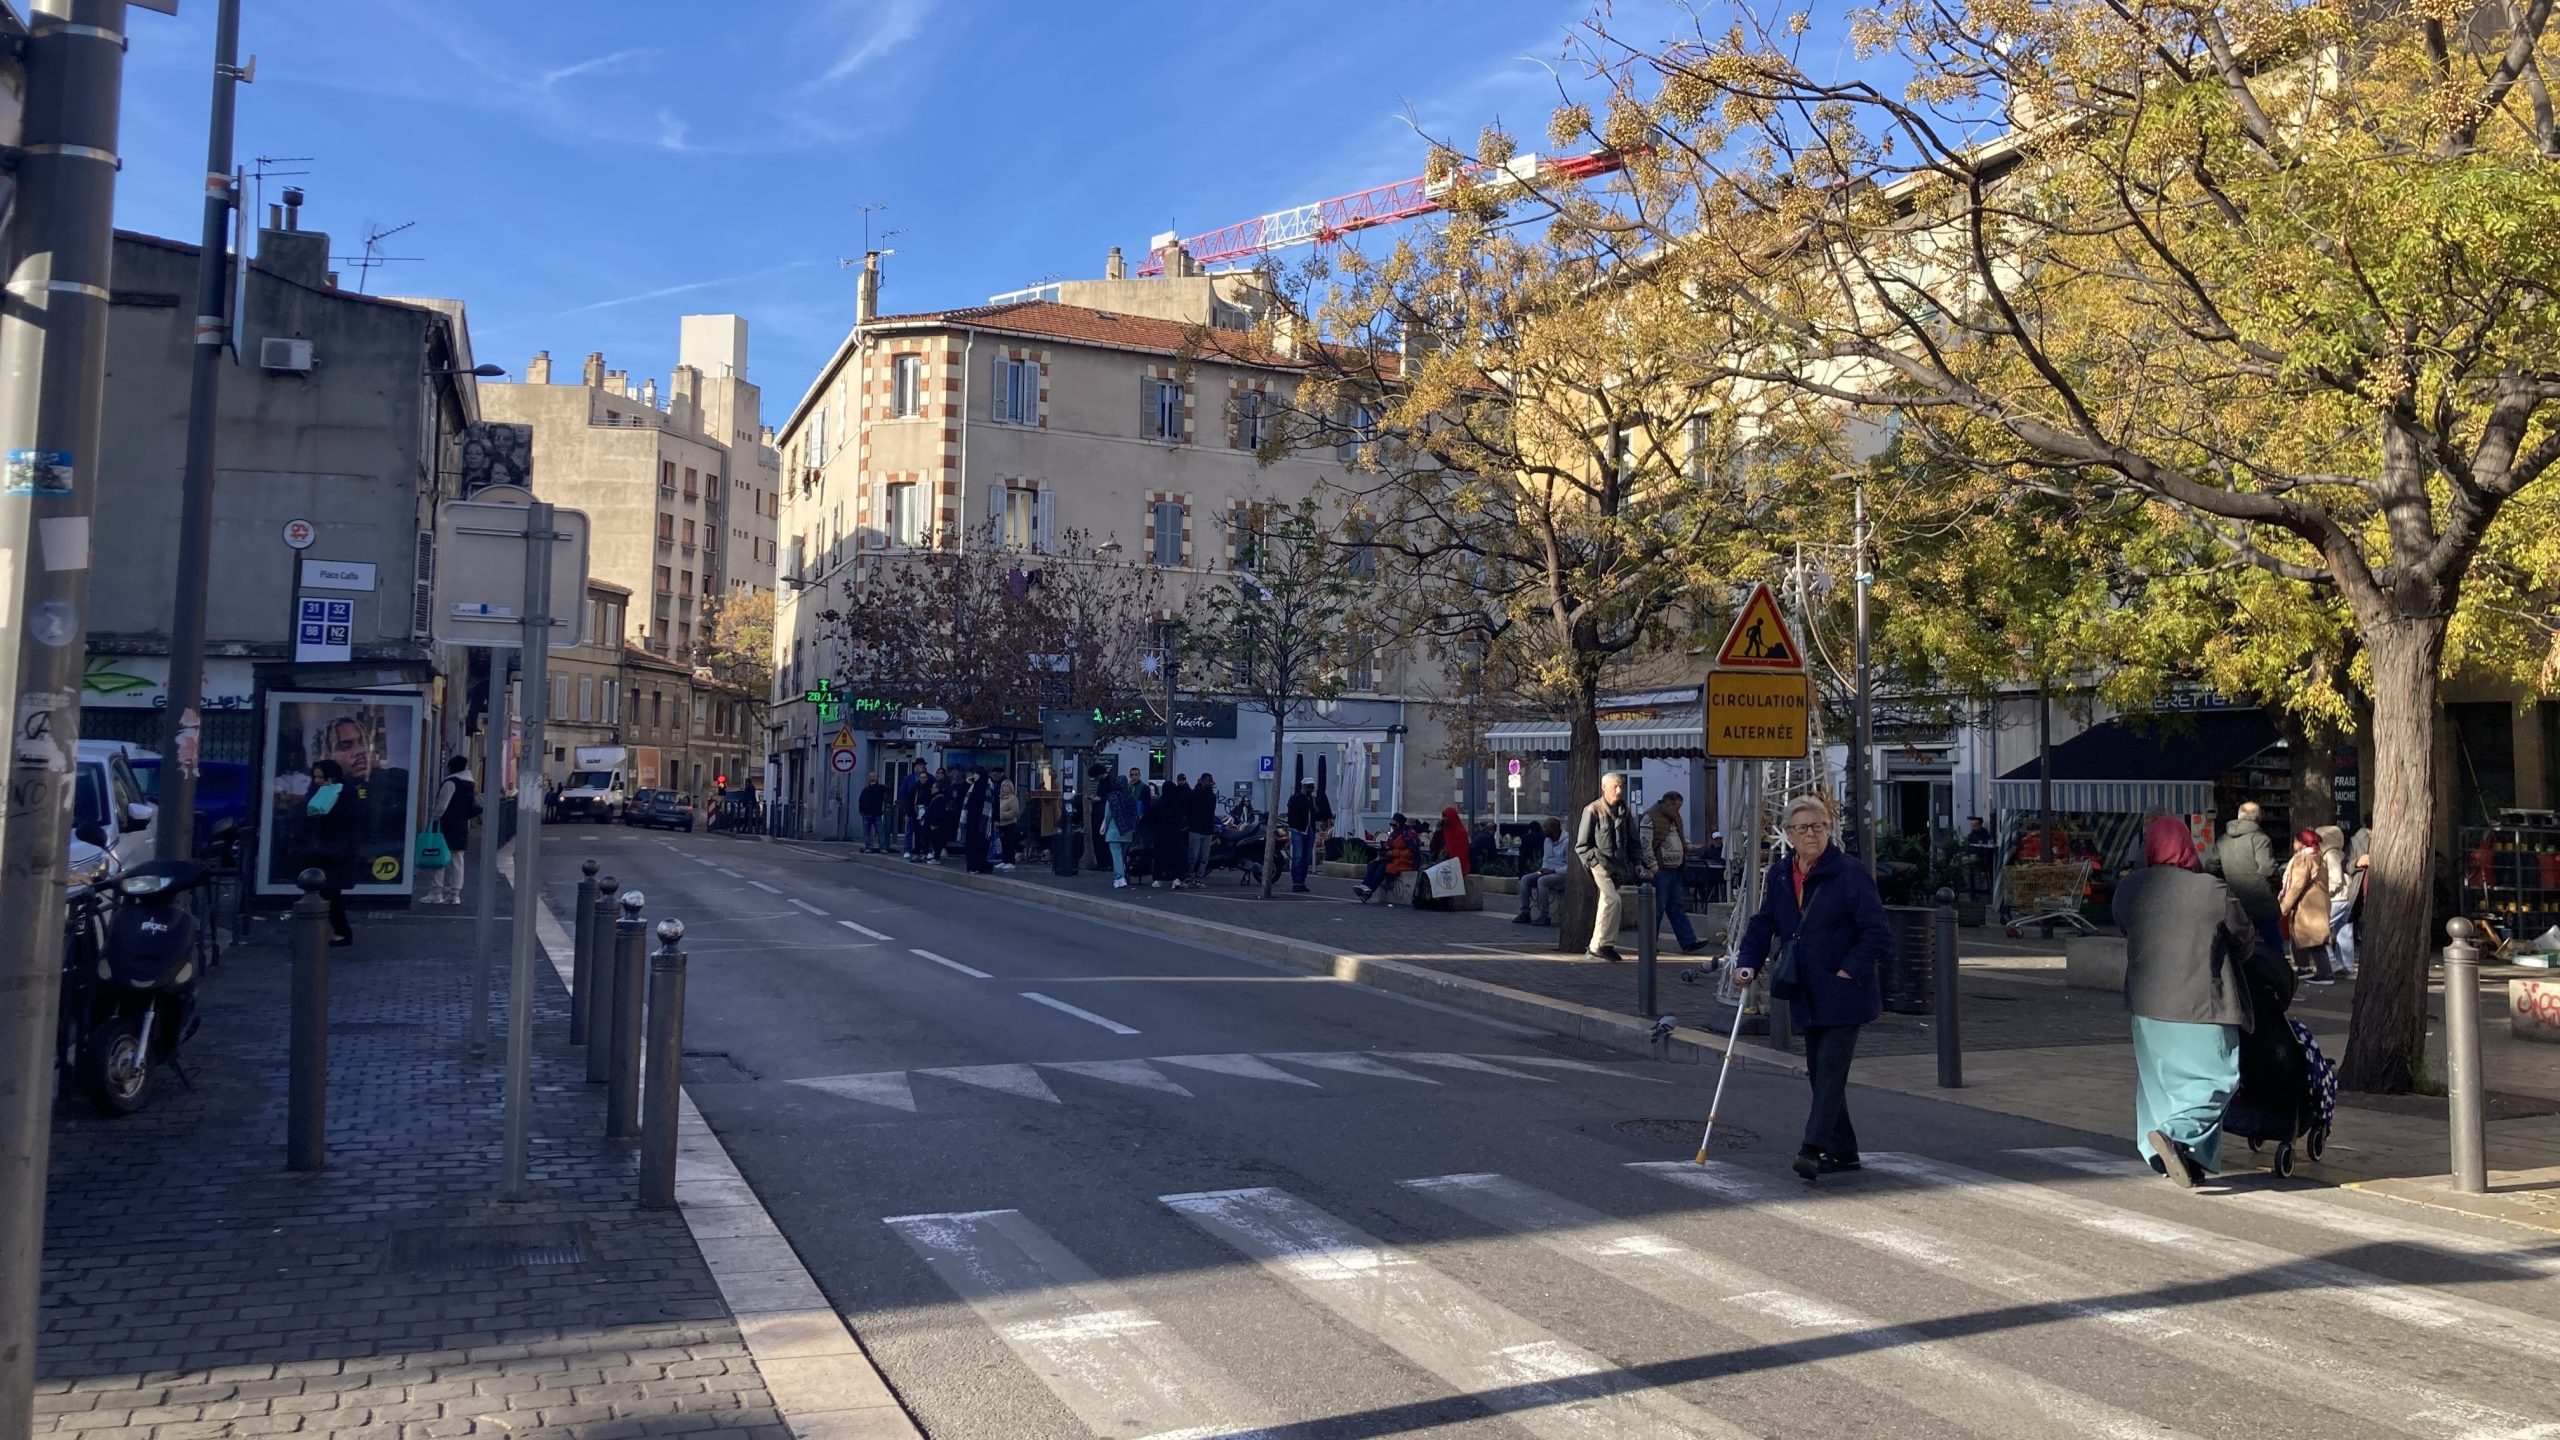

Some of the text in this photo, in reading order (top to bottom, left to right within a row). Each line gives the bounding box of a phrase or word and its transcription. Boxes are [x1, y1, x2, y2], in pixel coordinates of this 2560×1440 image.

[320, 570, 339, 579] Place
[307, 603, 320, 613] 31
[332, 604, 346, 614] 32
[330, 626, 345, 638] N2
[1712, 693, 1804, 708] CIRCULATION
[1723, 724, 1794, 740] ALTERNÉE
[2334, 776, 2356, 786] FRAIS
[376, 861, 396, 874] JD
